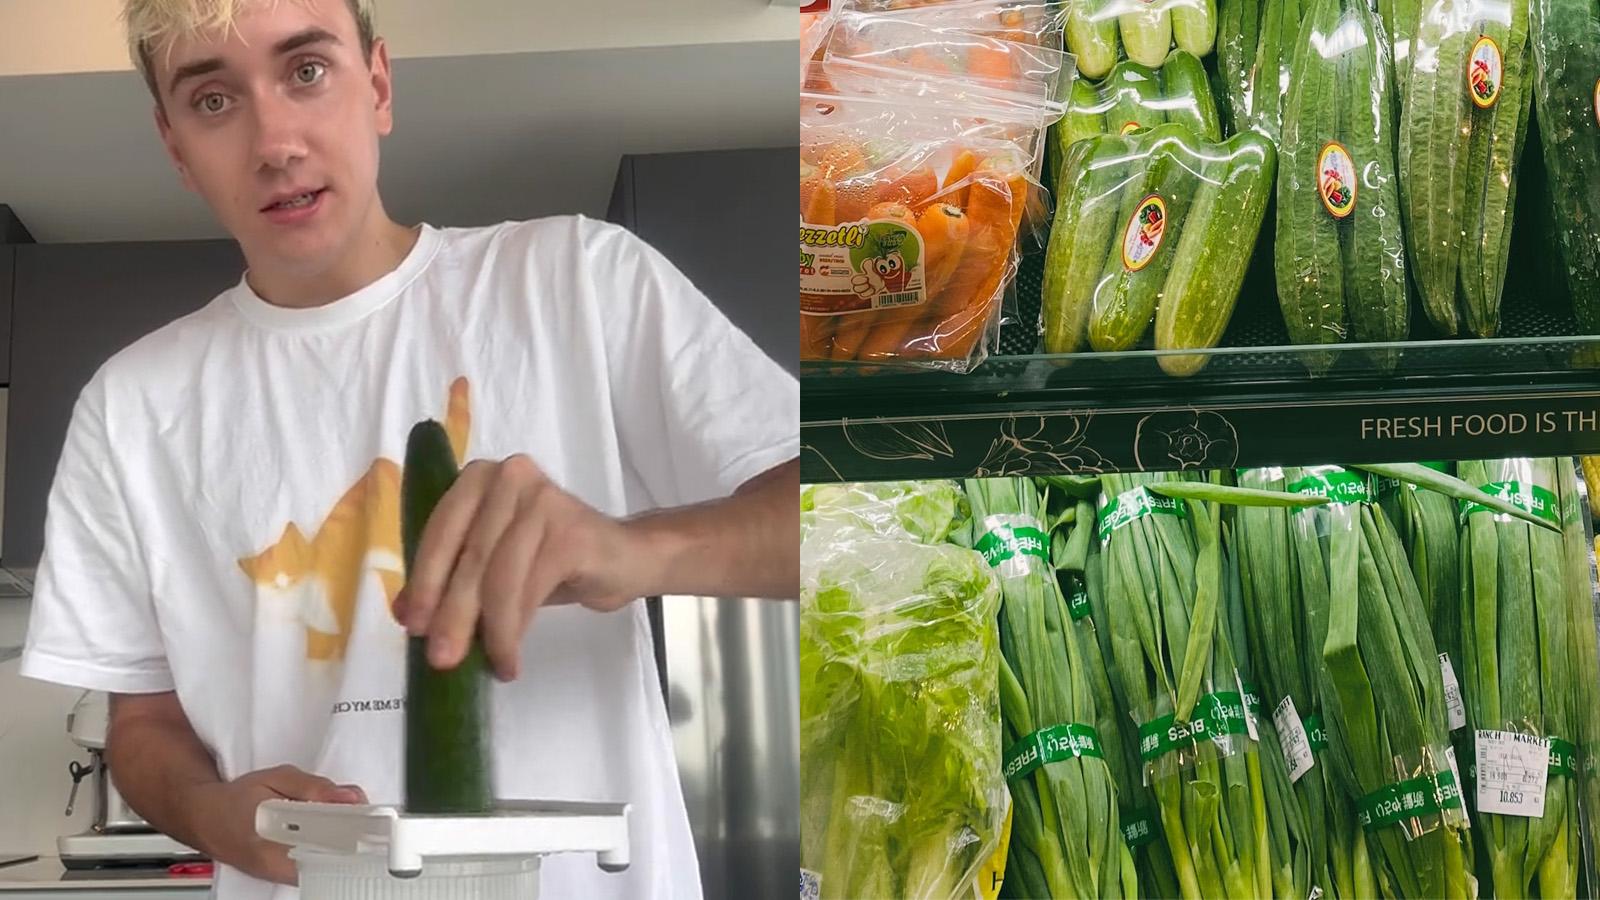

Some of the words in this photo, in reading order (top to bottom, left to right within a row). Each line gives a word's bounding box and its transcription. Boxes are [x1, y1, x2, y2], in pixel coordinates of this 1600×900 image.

[1361, 416, 1441, 439] FRESH
[1451, 413, 1527, 436] FOOD
[1535, 412, 1556, 433] IS
[1513, 733, 1548, 748] MARKET
[1500, 790, 1524, 804] 10.853
